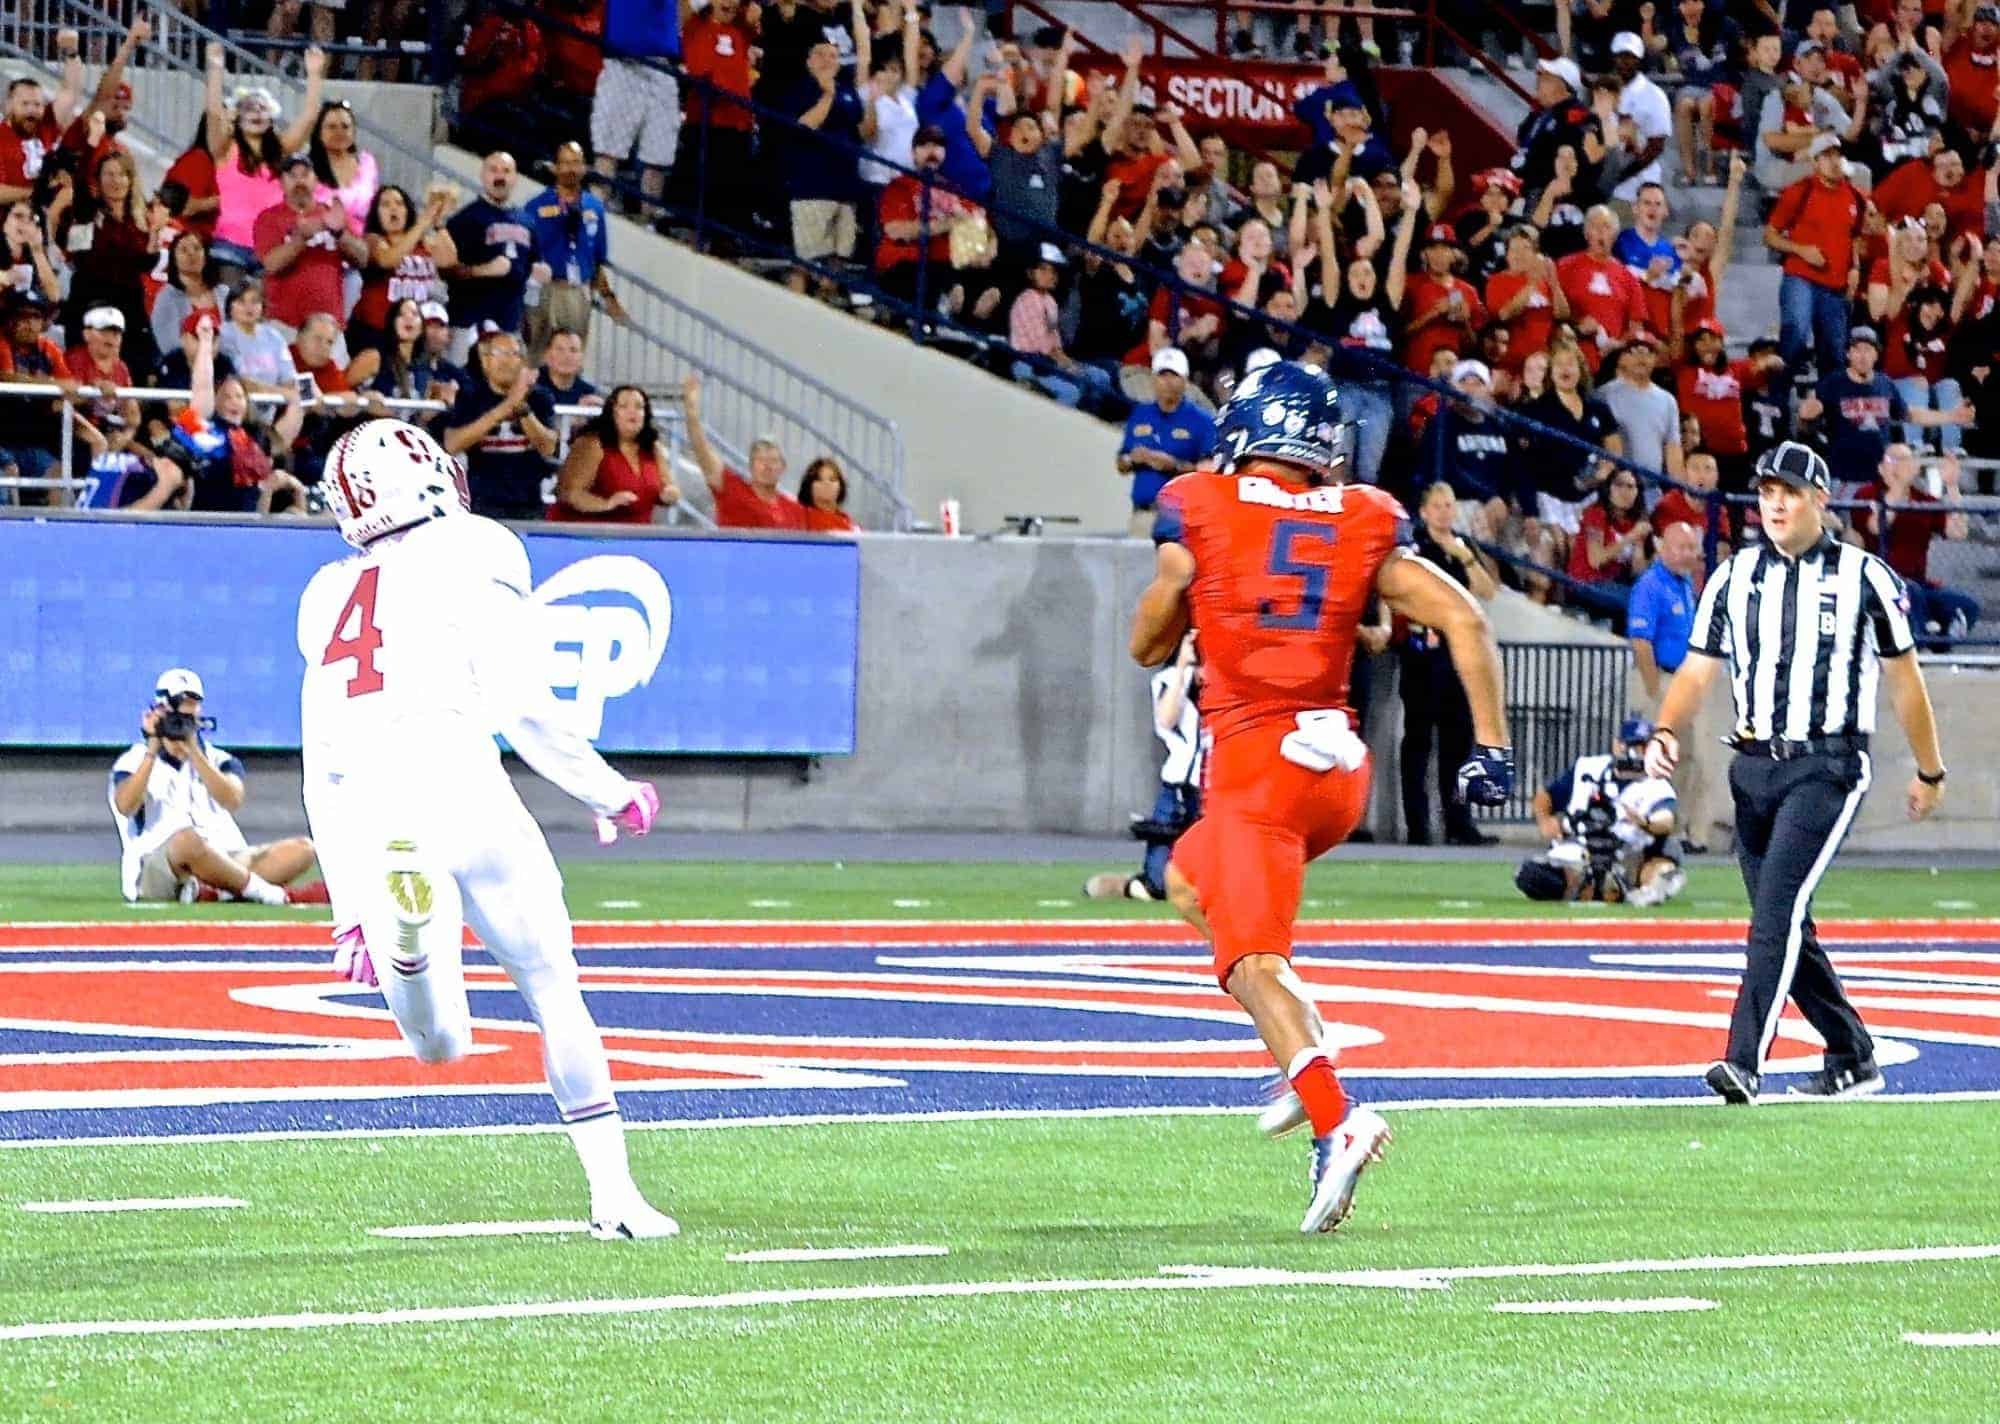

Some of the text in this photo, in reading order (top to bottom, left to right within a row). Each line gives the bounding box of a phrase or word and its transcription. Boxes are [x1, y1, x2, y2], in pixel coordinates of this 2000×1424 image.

[1167, 75, 1285, 121] SECTION
[1256, 517, 1337, 632] 5
[322, 566, 385, 699] 4
